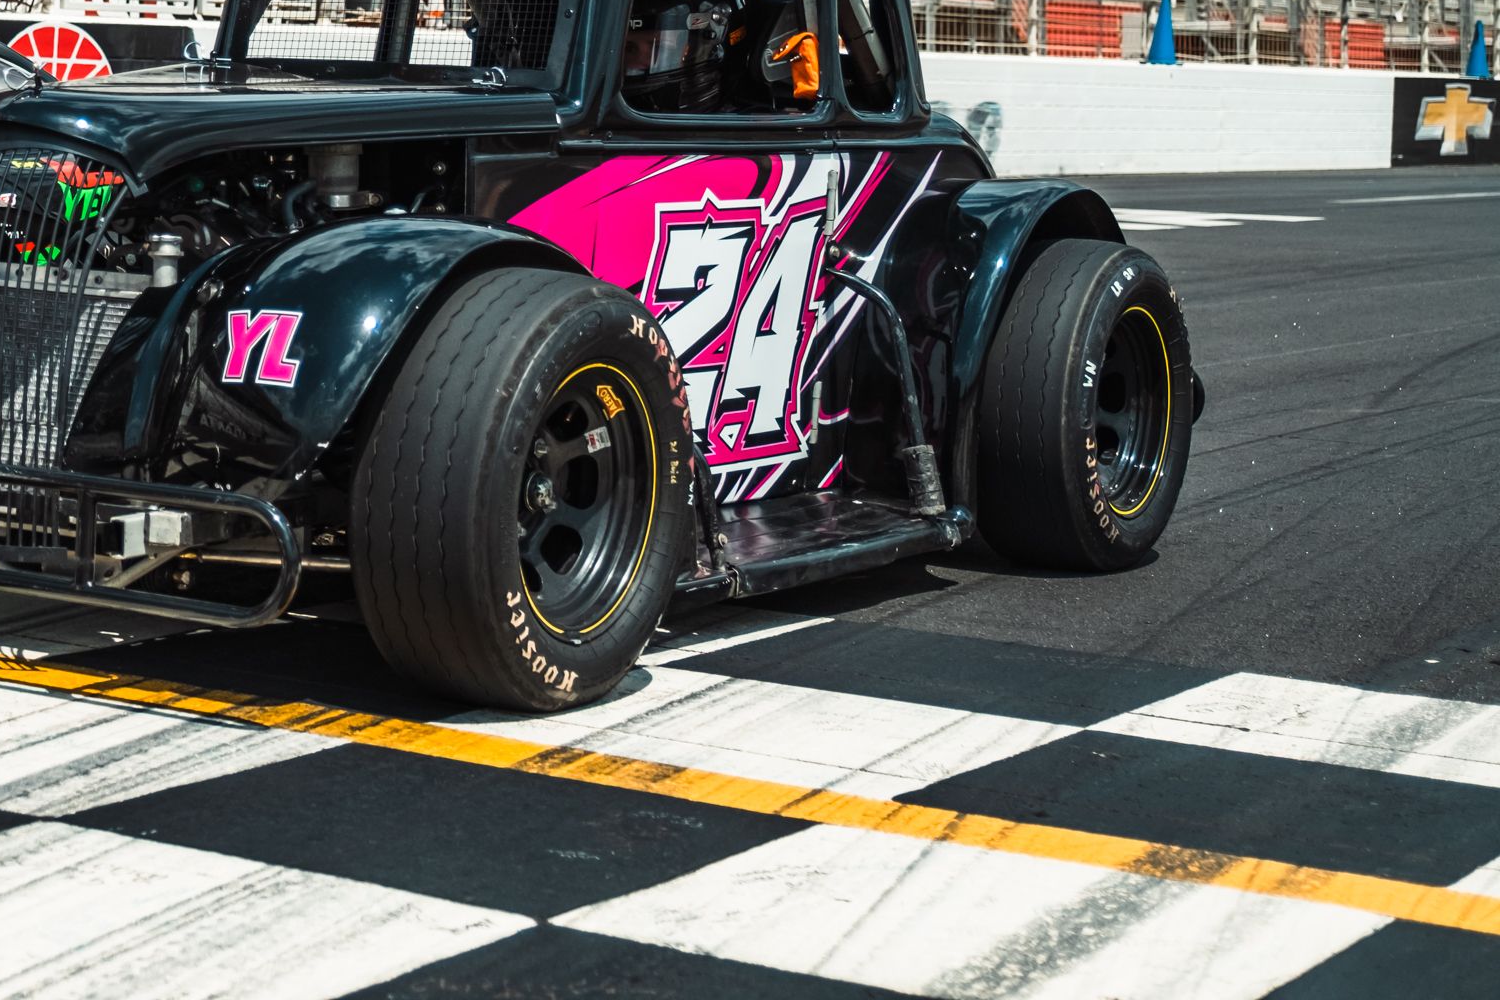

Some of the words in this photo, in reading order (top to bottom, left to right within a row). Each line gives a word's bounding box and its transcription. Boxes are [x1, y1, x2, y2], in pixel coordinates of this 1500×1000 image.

[222, 310, 303, 388] YL
[654, 210, 827, 448] 24
[599, 388, 618, 411] AERO
